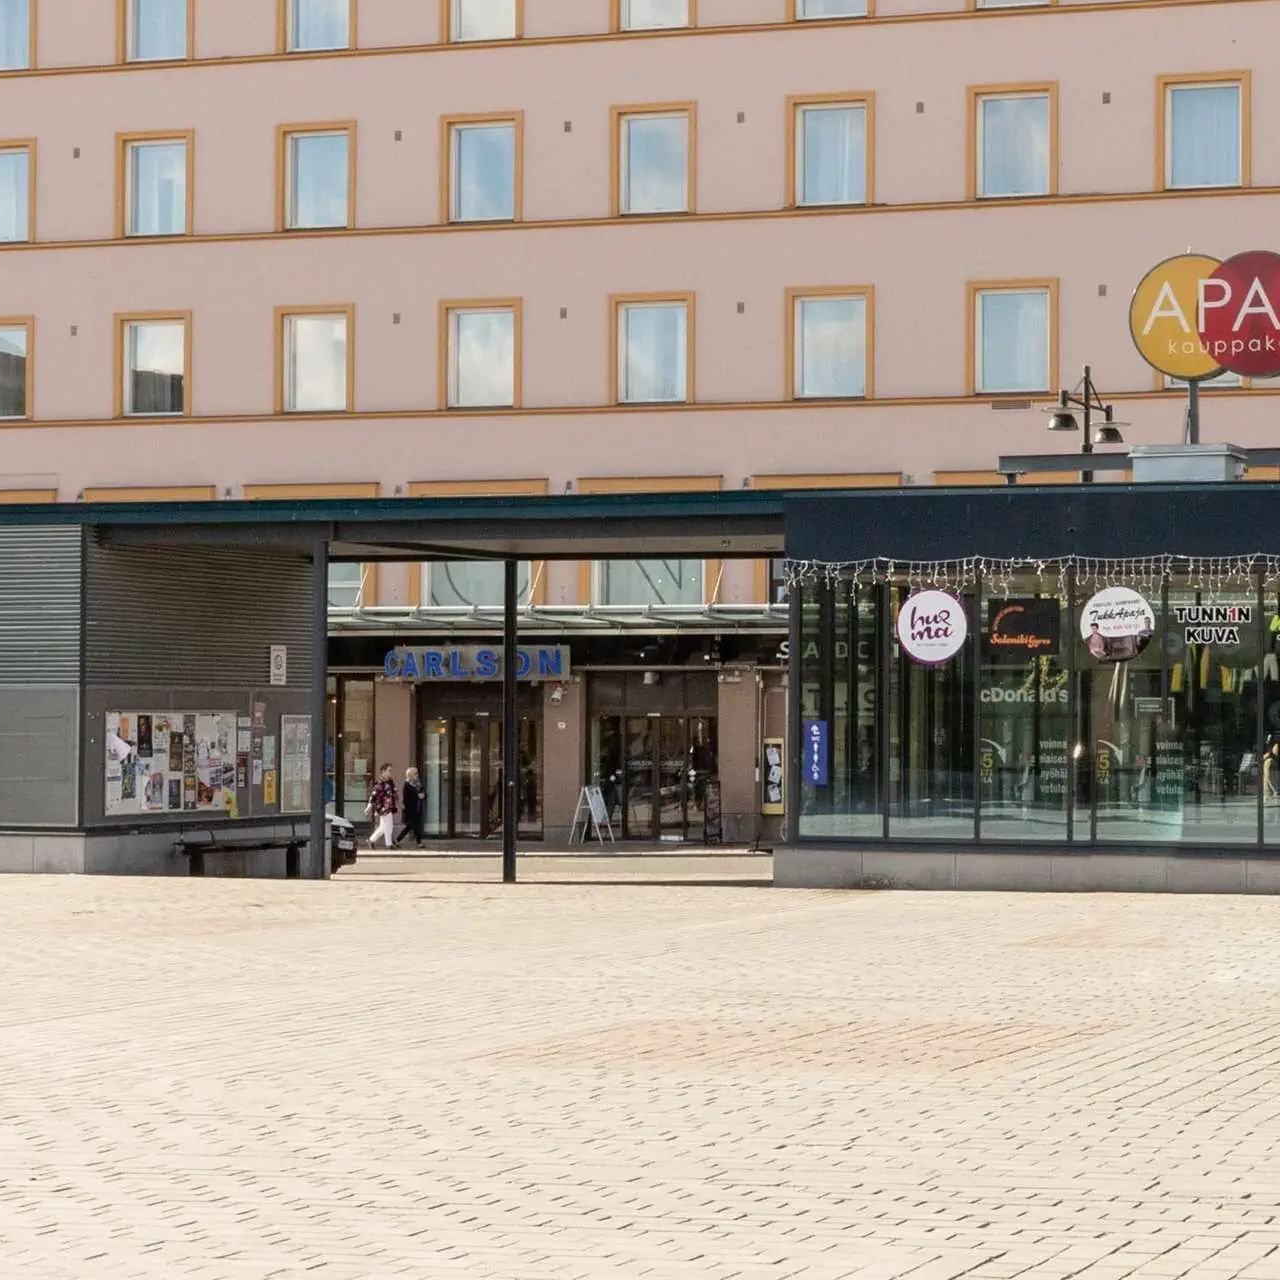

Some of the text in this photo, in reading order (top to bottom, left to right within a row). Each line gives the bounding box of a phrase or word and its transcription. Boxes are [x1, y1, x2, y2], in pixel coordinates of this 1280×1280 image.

[1186, 626, 1239, 644] KUVA
[384, 648, 563, 679] CARLSON
[980, 687, 1069, 704] cDonald's
